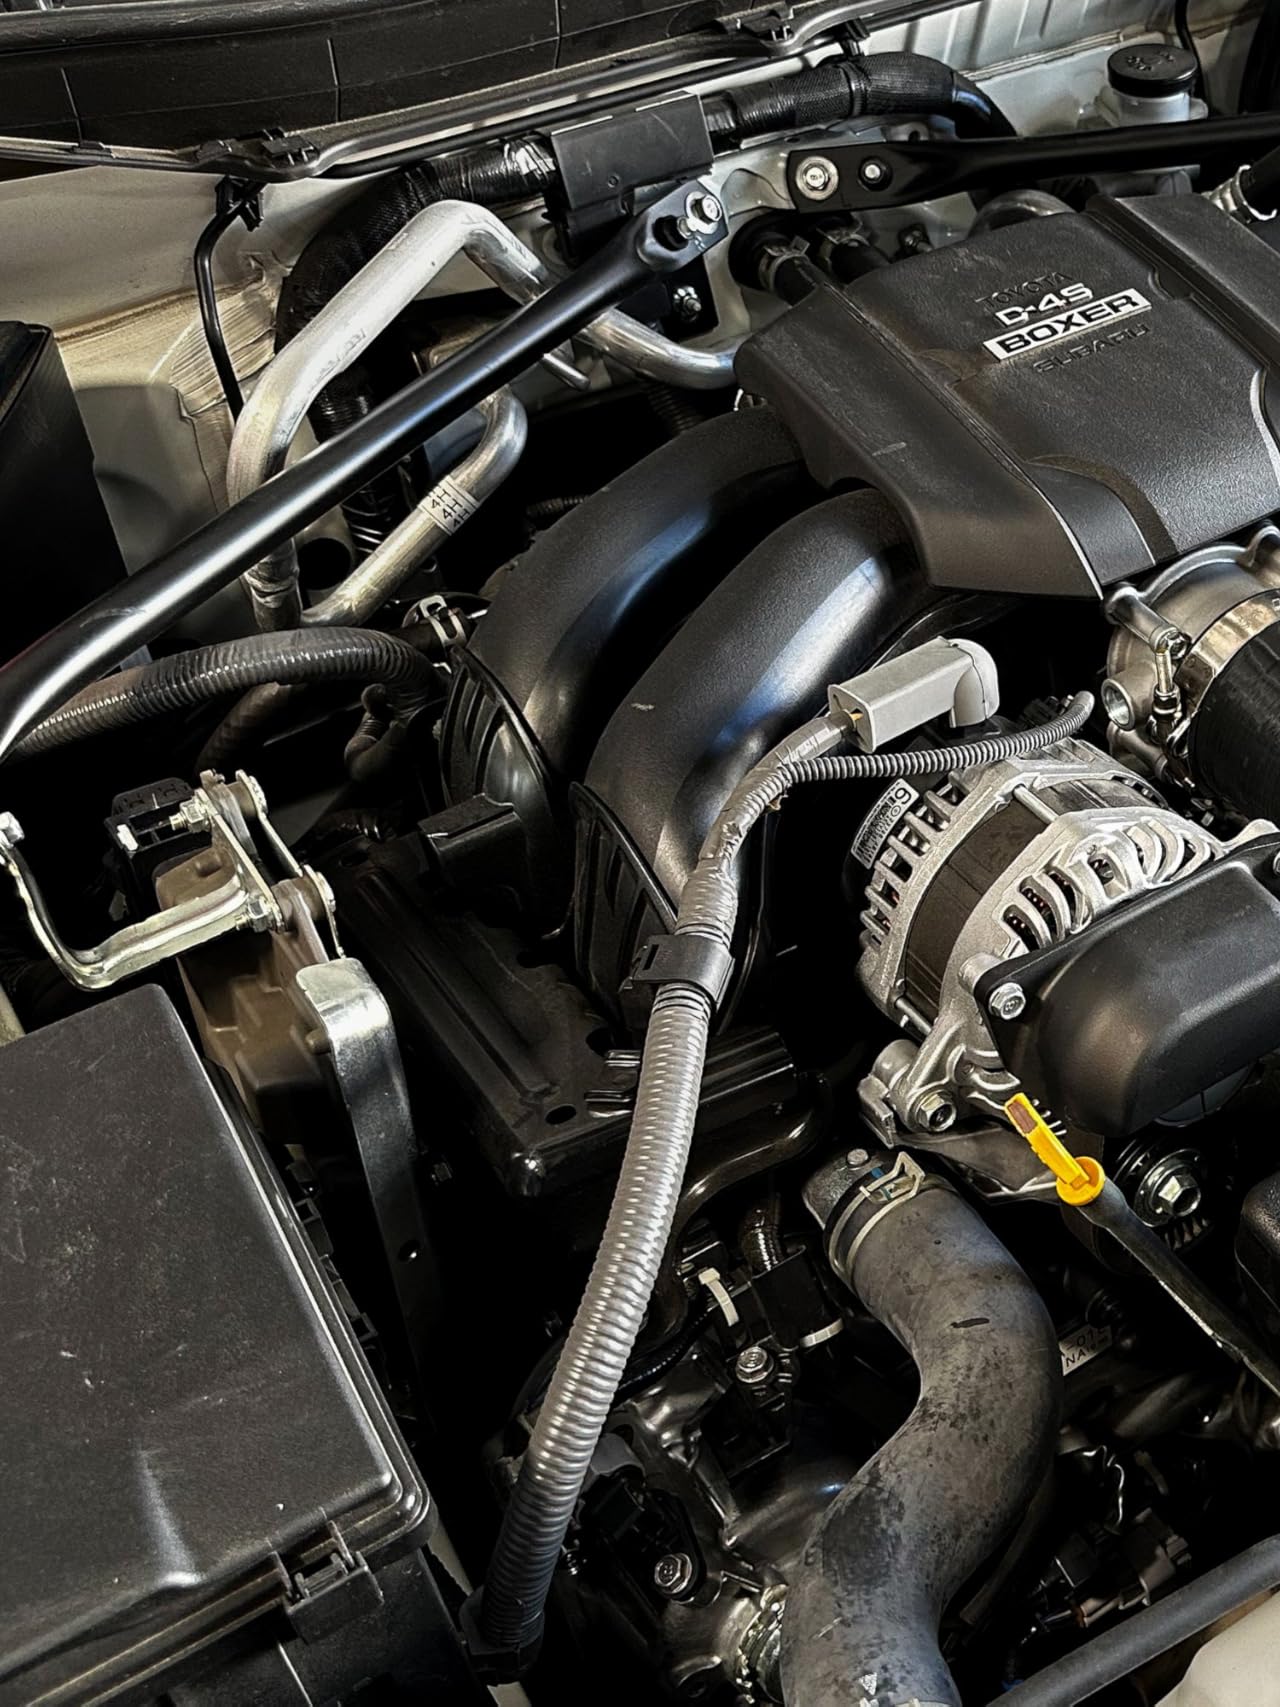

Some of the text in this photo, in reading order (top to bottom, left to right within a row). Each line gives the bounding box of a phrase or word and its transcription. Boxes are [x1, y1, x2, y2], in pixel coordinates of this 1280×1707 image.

[975, 271, 1073, 308] TOYOTA
[995, 282, 1094, 328] D-4S
[996, 294, 1140, 354] BOXER
[1033, 323, 1149, 373] SUBARU
